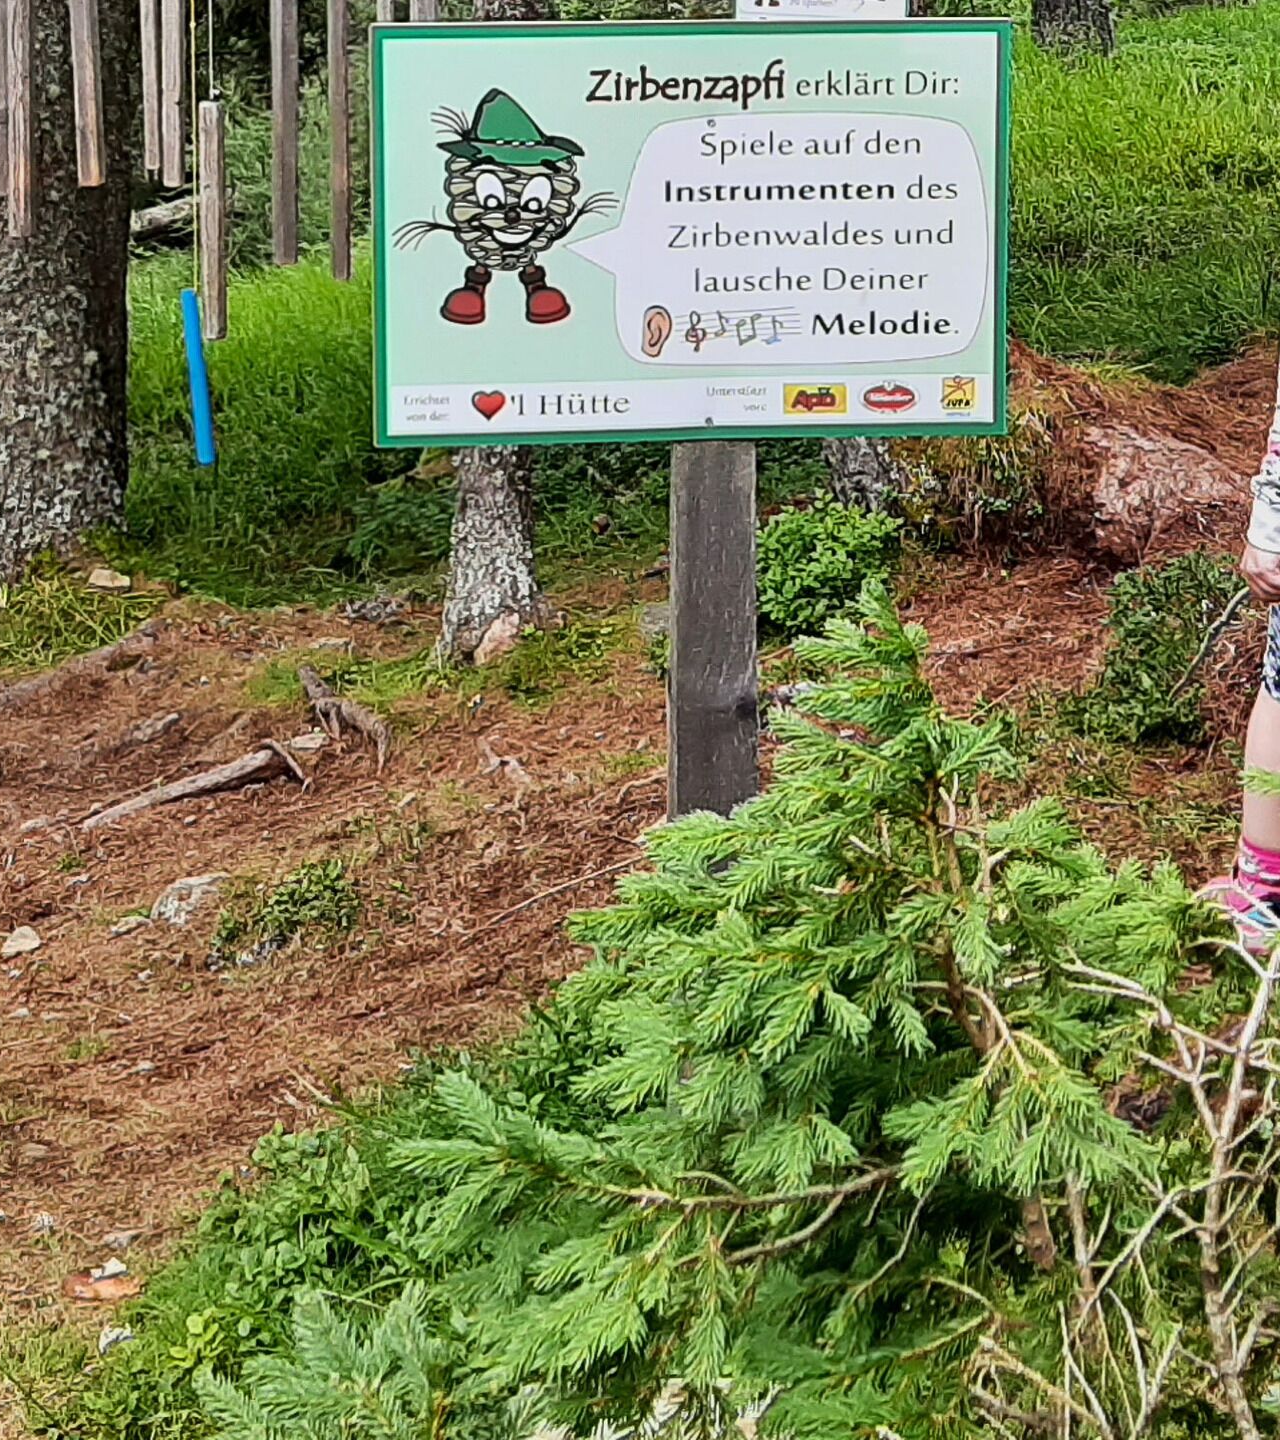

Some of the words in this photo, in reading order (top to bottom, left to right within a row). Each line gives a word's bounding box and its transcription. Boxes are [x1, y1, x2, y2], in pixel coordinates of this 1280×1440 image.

[586, 59, 785, 110] Zirbenzapfi
[795, 70, 896, 97] erklärt
[905, 70, 960, 96] Dir:
[699, 130, 795, 164] Spiele
[803, 129, 856, 156] auf
[864, 129, 922, 155] den
[664, 177, 895, 203] Instrumenten
[906, 174, 959, 200] des
[667, 221, 884, 249] Zirbenwaldes
[894, 219, 954, 246] und
[694, 266, 812, 293] lausche
[823, 266, 929, 292] Deiner
[811, 310, 960, 336] Melodie.
[540, 393, 631, 416] Hütte
